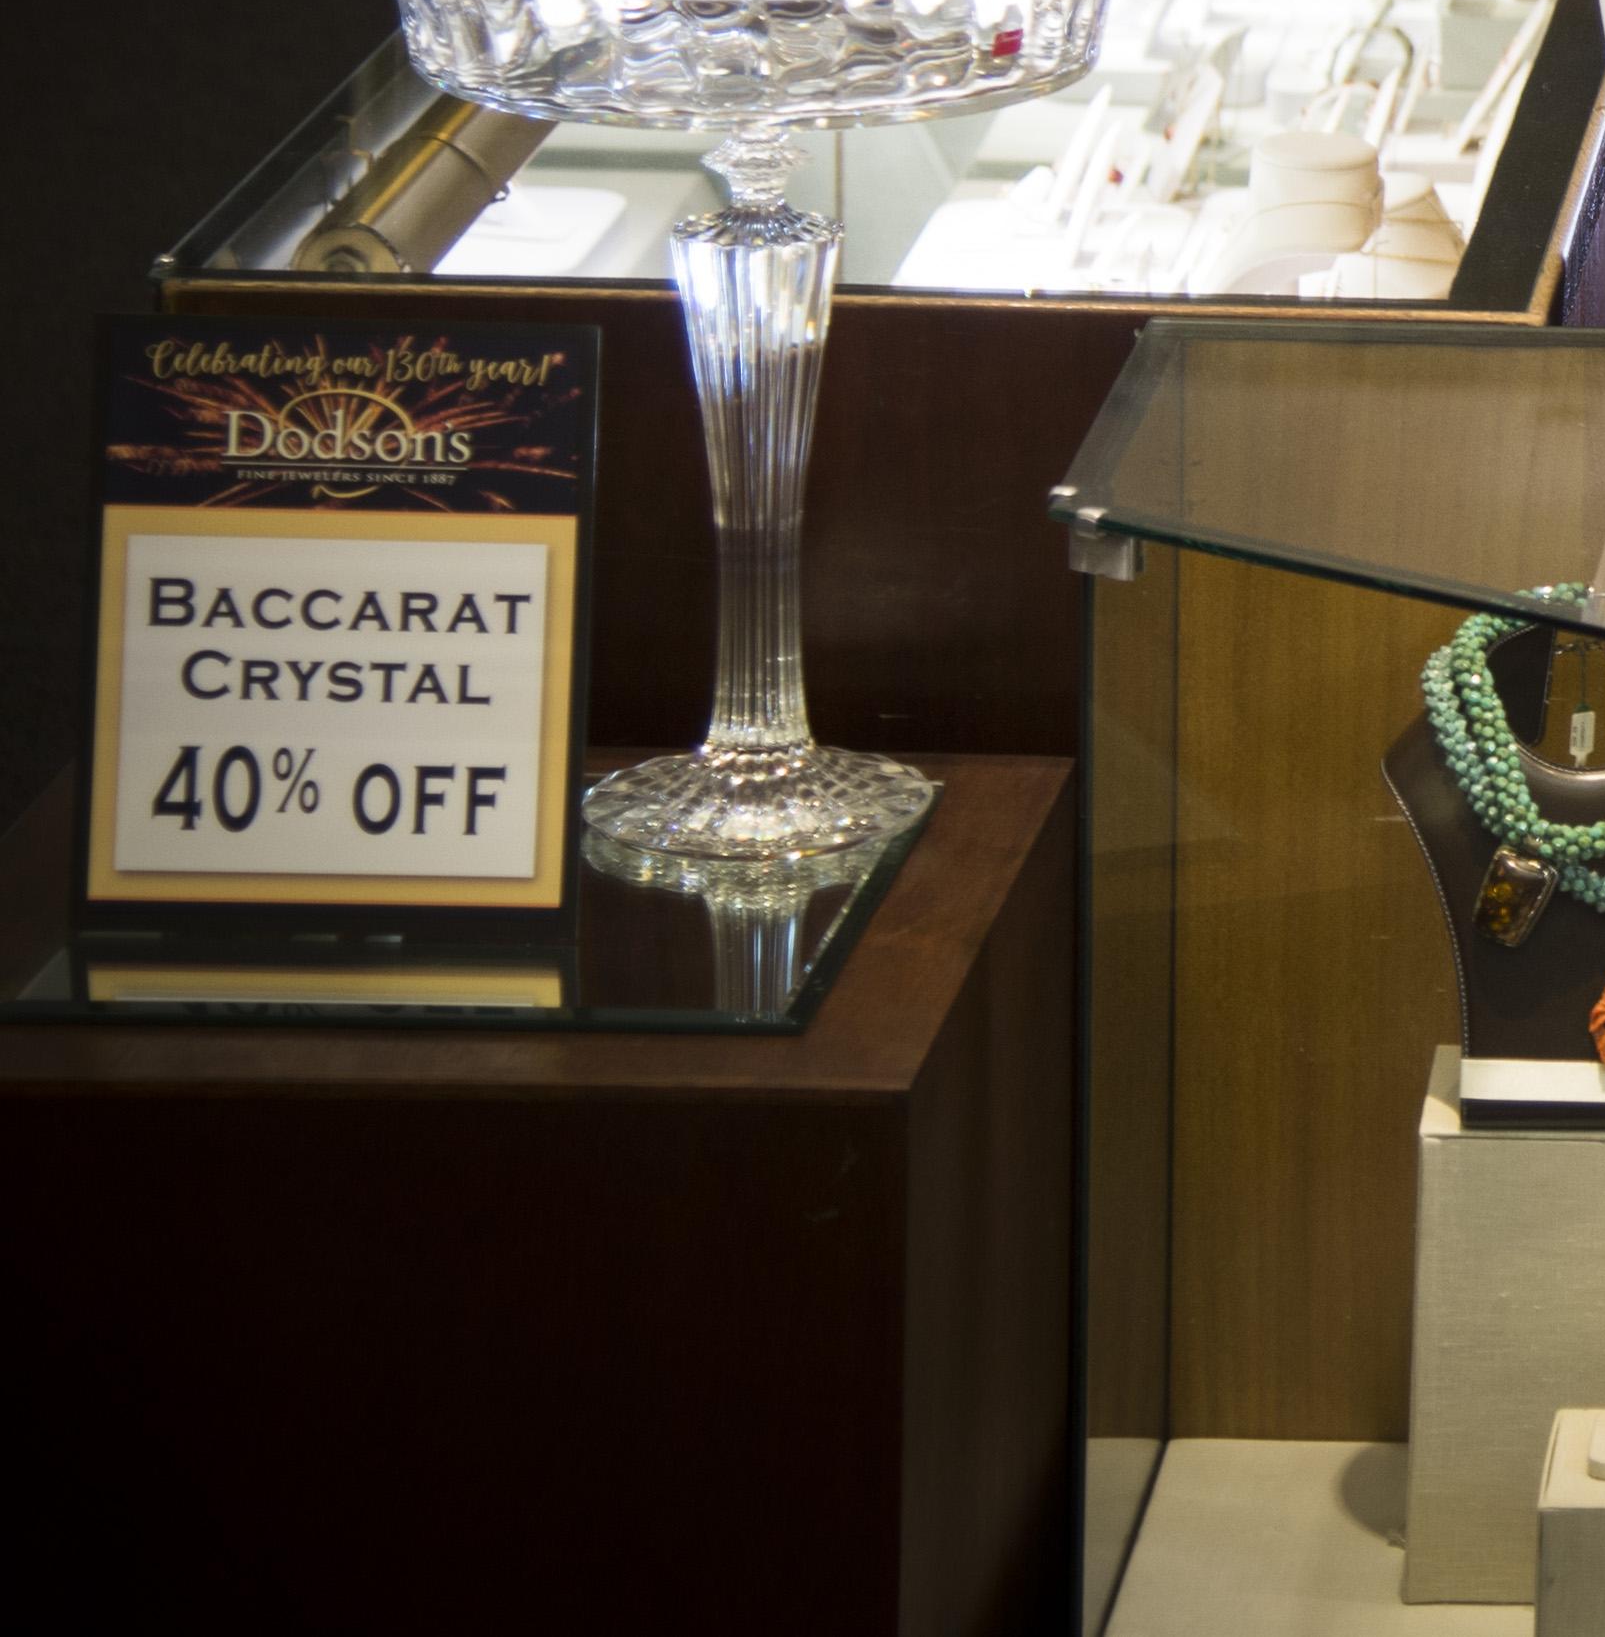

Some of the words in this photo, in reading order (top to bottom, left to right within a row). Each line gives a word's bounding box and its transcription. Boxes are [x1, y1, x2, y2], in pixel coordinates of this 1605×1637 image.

[145, 339, 326, 385] Celebrating
[332, 356, 379, 377] our
[385, 348, 462, 383] 130th
[465, 353, 550, 392] year!
[222, 409, 472, 463] Dodson's
[238, 469, 276, 480] FINE
[281, 471, 360, 482] JEWELERS
[367, 473, 415, 483] SINCE
[423, 473, 457, 485] 1887
[148, 577, 532, 634] BACCARAT
[180, 649, 492, 706] CRYSTAL
[151, 744, 321, 833] 40%
[352, 762, 507, 836] OFF
